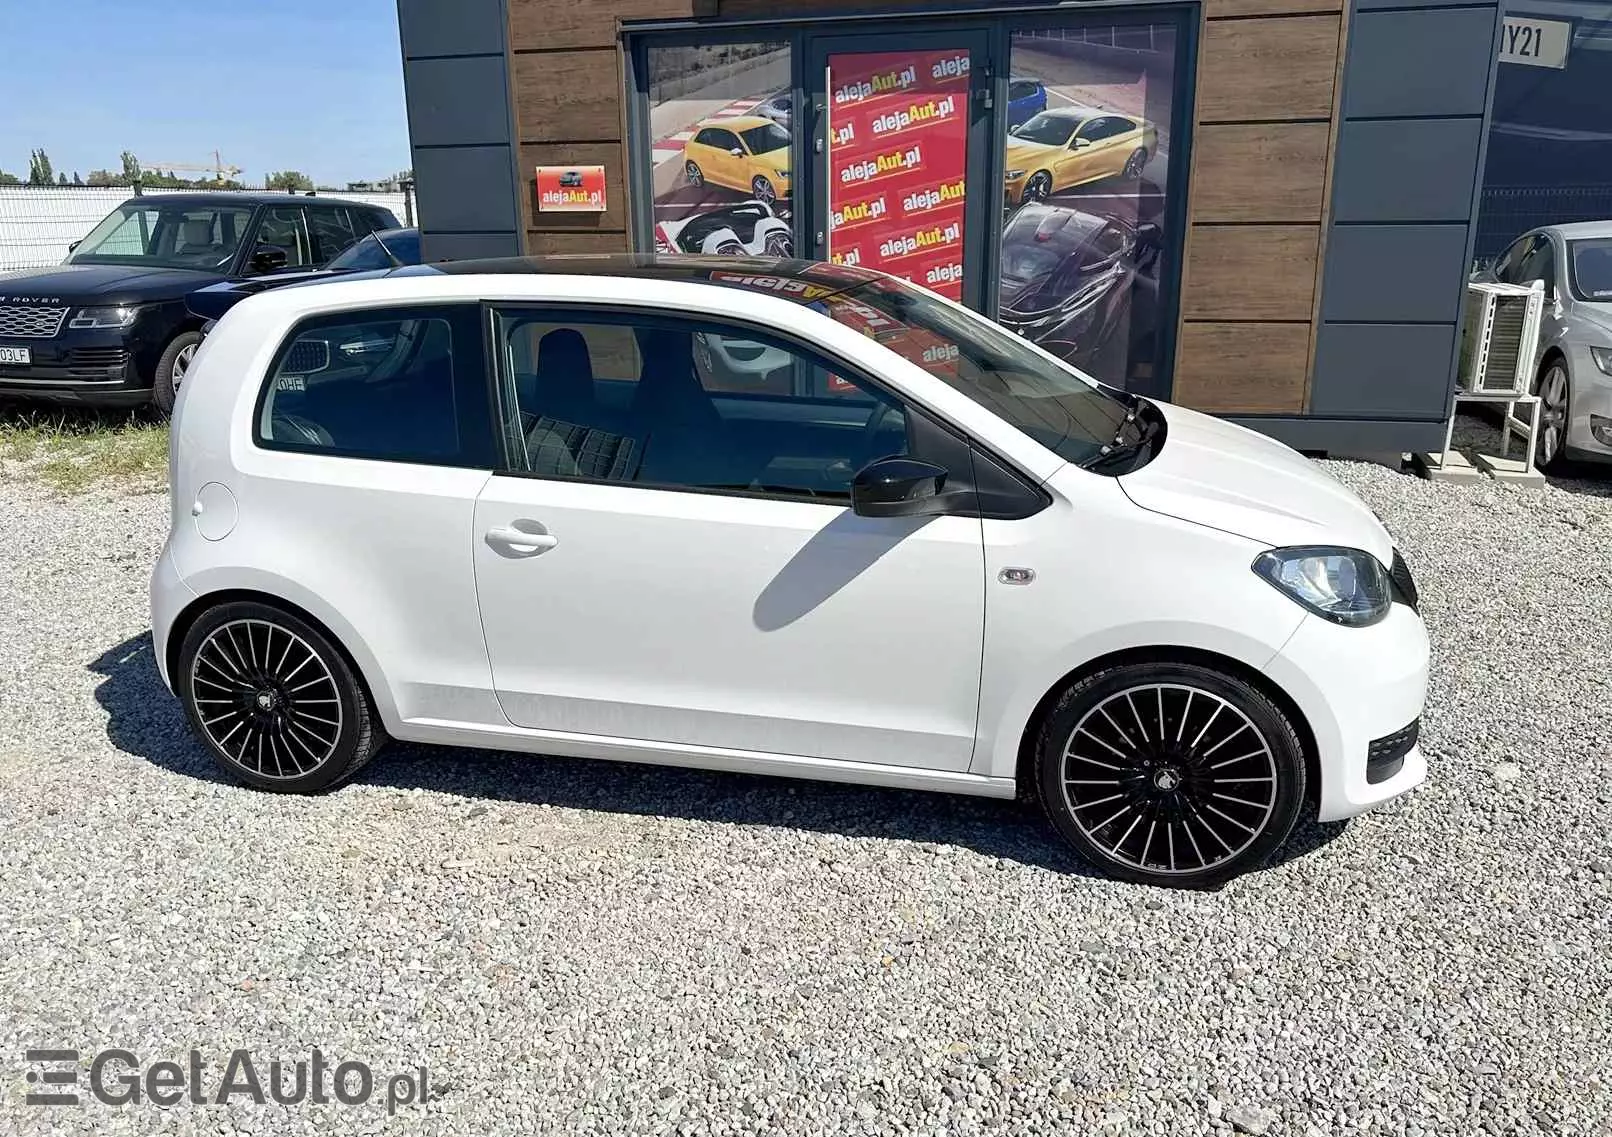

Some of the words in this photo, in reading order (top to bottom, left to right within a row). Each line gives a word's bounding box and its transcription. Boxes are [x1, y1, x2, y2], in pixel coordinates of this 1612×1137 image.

[932, 55, 970, 79] aleja
[834, 65, 917, 104] alejaAut.pl
[872, 95, 955, 134] alejaAut.pl
[840, 145, 921, 182] alejaAut.pl
[542, 190, 602, 206] alejaAut.pl
[903, 180, 965, 212] alejaAut
[879, 222, 960, 257] alejaAut.pl
[926, 262, 963, 284] aleja
[922, 343, 960, 363] aleja
